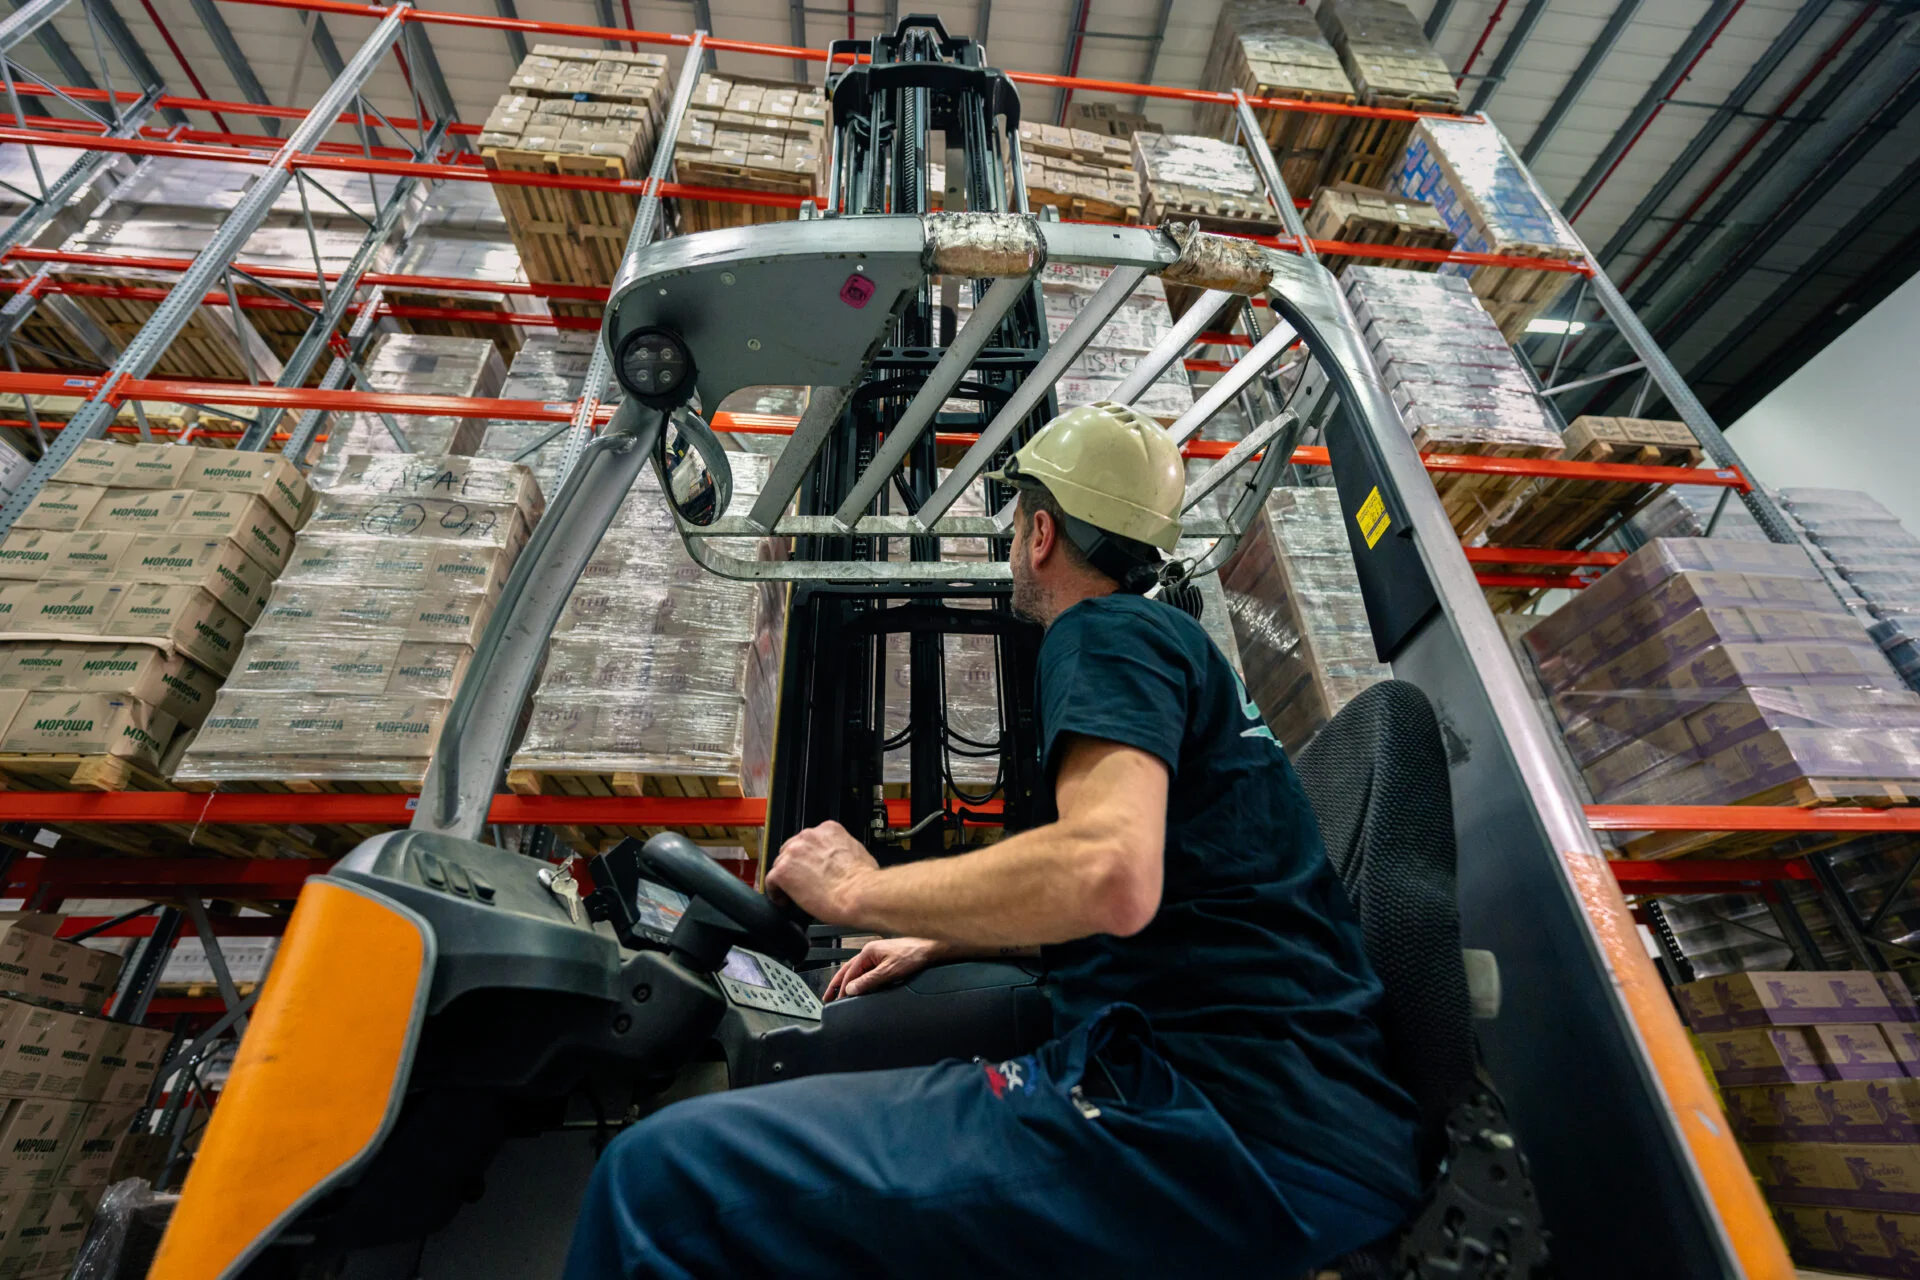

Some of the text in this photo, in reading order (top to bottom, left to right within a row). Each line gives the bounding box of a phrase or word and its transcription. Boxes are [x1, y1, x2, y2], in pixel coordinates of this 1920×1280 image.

[203, 468, 252, 478] МОРОША
[275, 478, 301, 510] МОРОША
[110, 508, 159, 517] МОРОША
[251, 525, 280, 557] МОРОША
[141, 556, 193, 567] МОРОША
[216, 564, 250, 595] МОРОША
[41, 604, 94, 615] МОРОША
[419, 613, 470, 625] МОРОША
[195, 620, 231, 650] МОРОША
[18, 658, 63, 667] MOROSHA
[82, 660, 138, 672] МОРОША
[247, 661, 300, 671] МОРОША
[162, 673, 201, 701] MOROSHA
[33, 719, 94, 732] МОРОША
[205, 718, 259, 729] МОРОША
[375, 721, 429, 734] МОРОША
[13, 1138, 58, 1152] МОРОША
